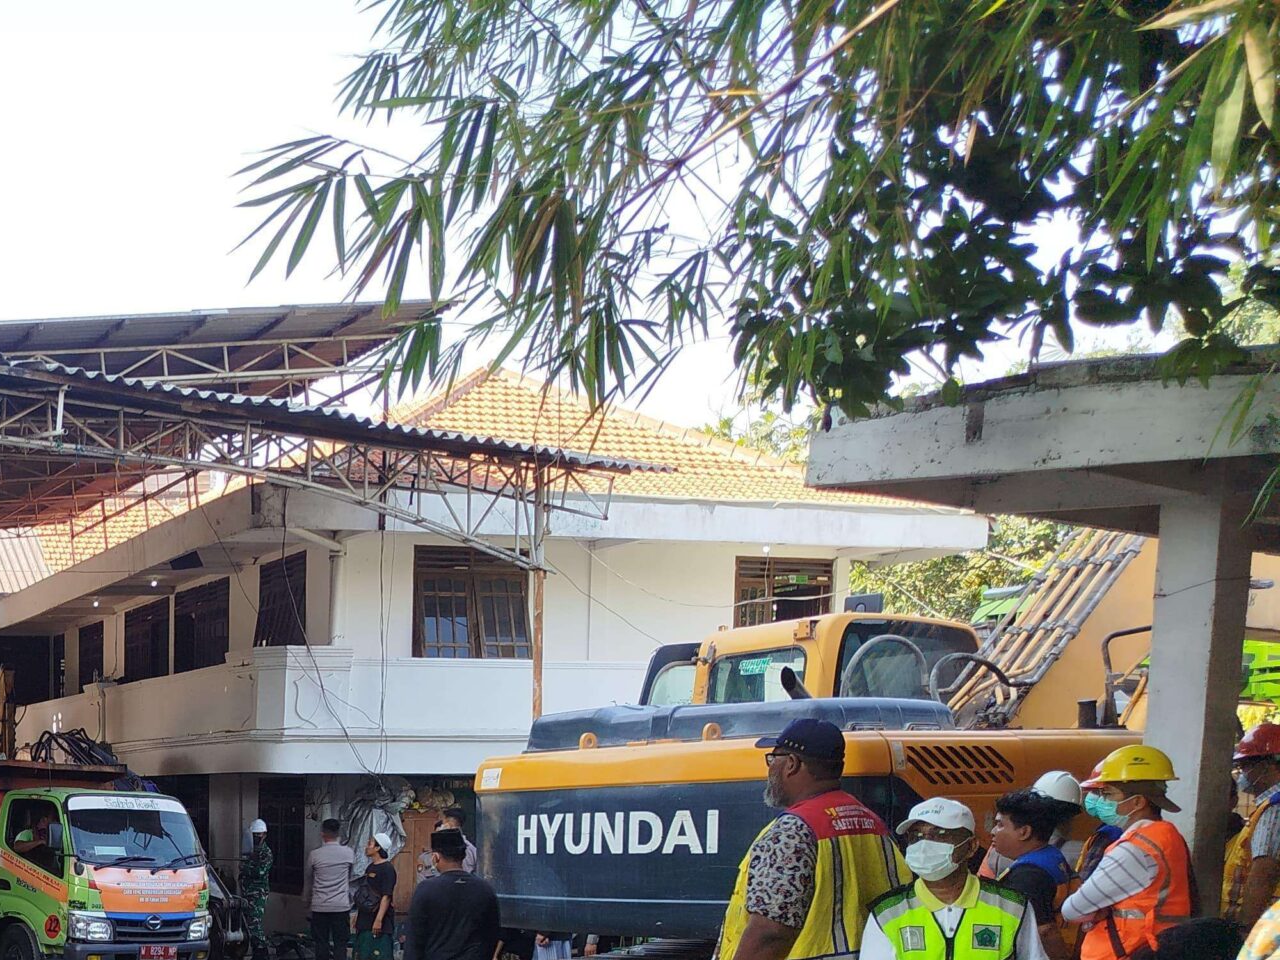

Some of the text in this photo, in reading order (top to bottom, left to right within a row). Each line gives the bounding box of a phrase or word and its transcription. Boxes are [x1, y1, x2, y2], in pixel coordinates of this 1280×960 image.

[832, 817, 876, 831] SAFETY IRST
[517, 809, 719, 855] HYUNDAI
[150, 946, 165, 956] 8294
